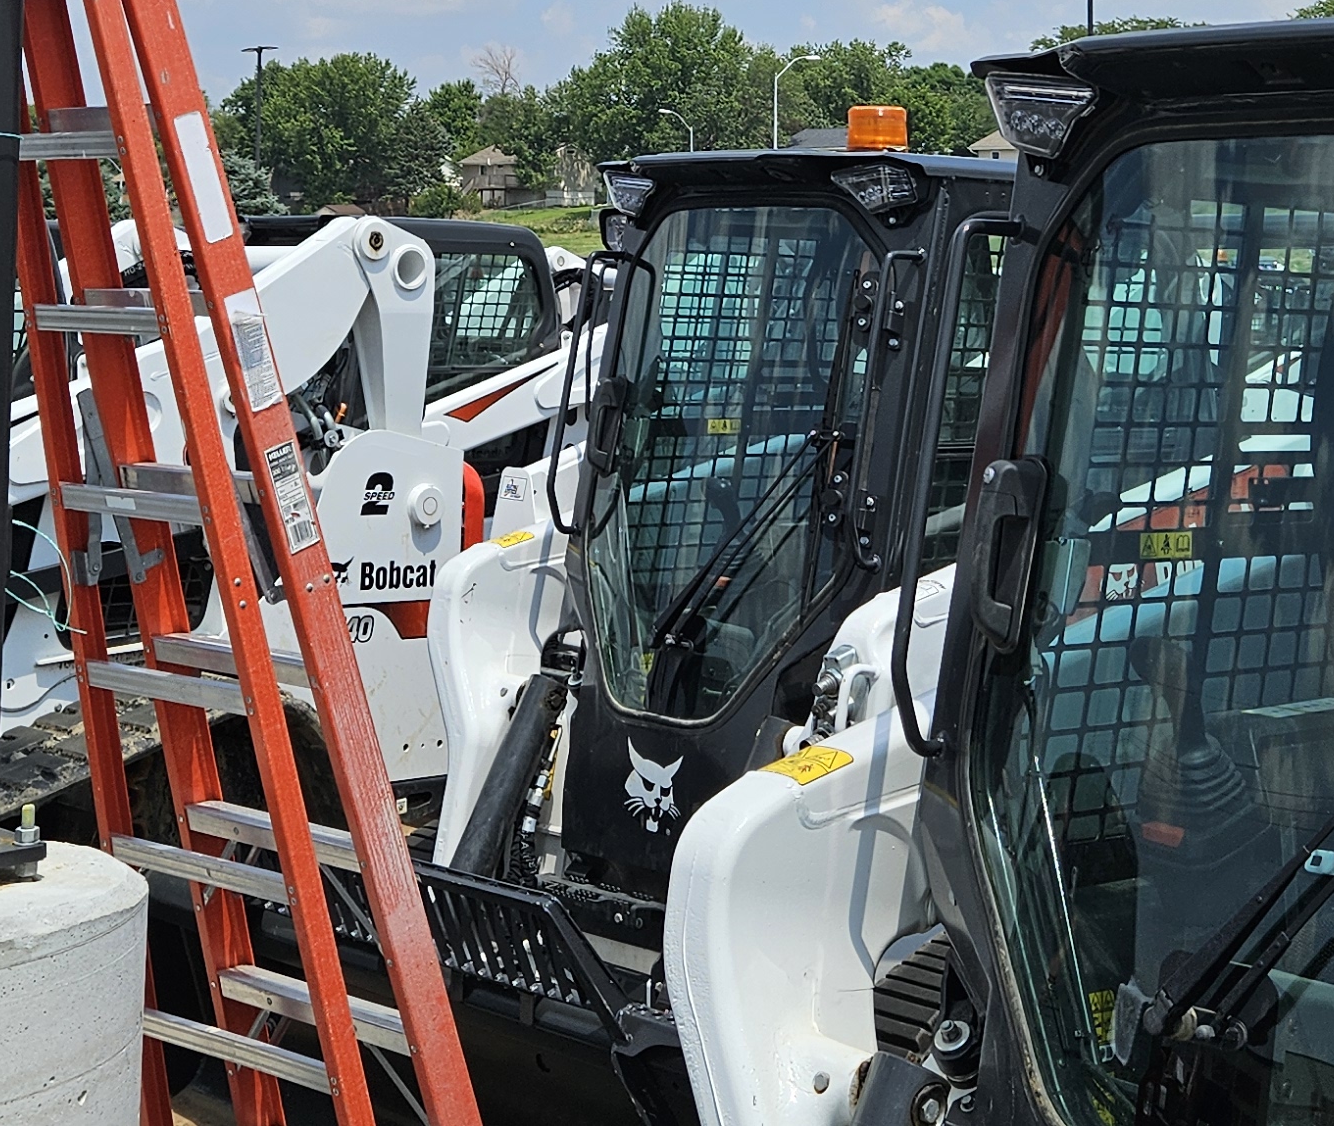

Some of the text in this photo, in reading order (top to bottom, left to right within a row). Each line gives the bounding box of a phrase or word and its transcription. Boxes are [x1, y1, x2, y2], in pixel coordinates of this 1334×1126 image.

[360, 471, 394, 516] 2
[363, 491, 396, 501] SPEED
[360, 559, 437, 591] Bobcat
